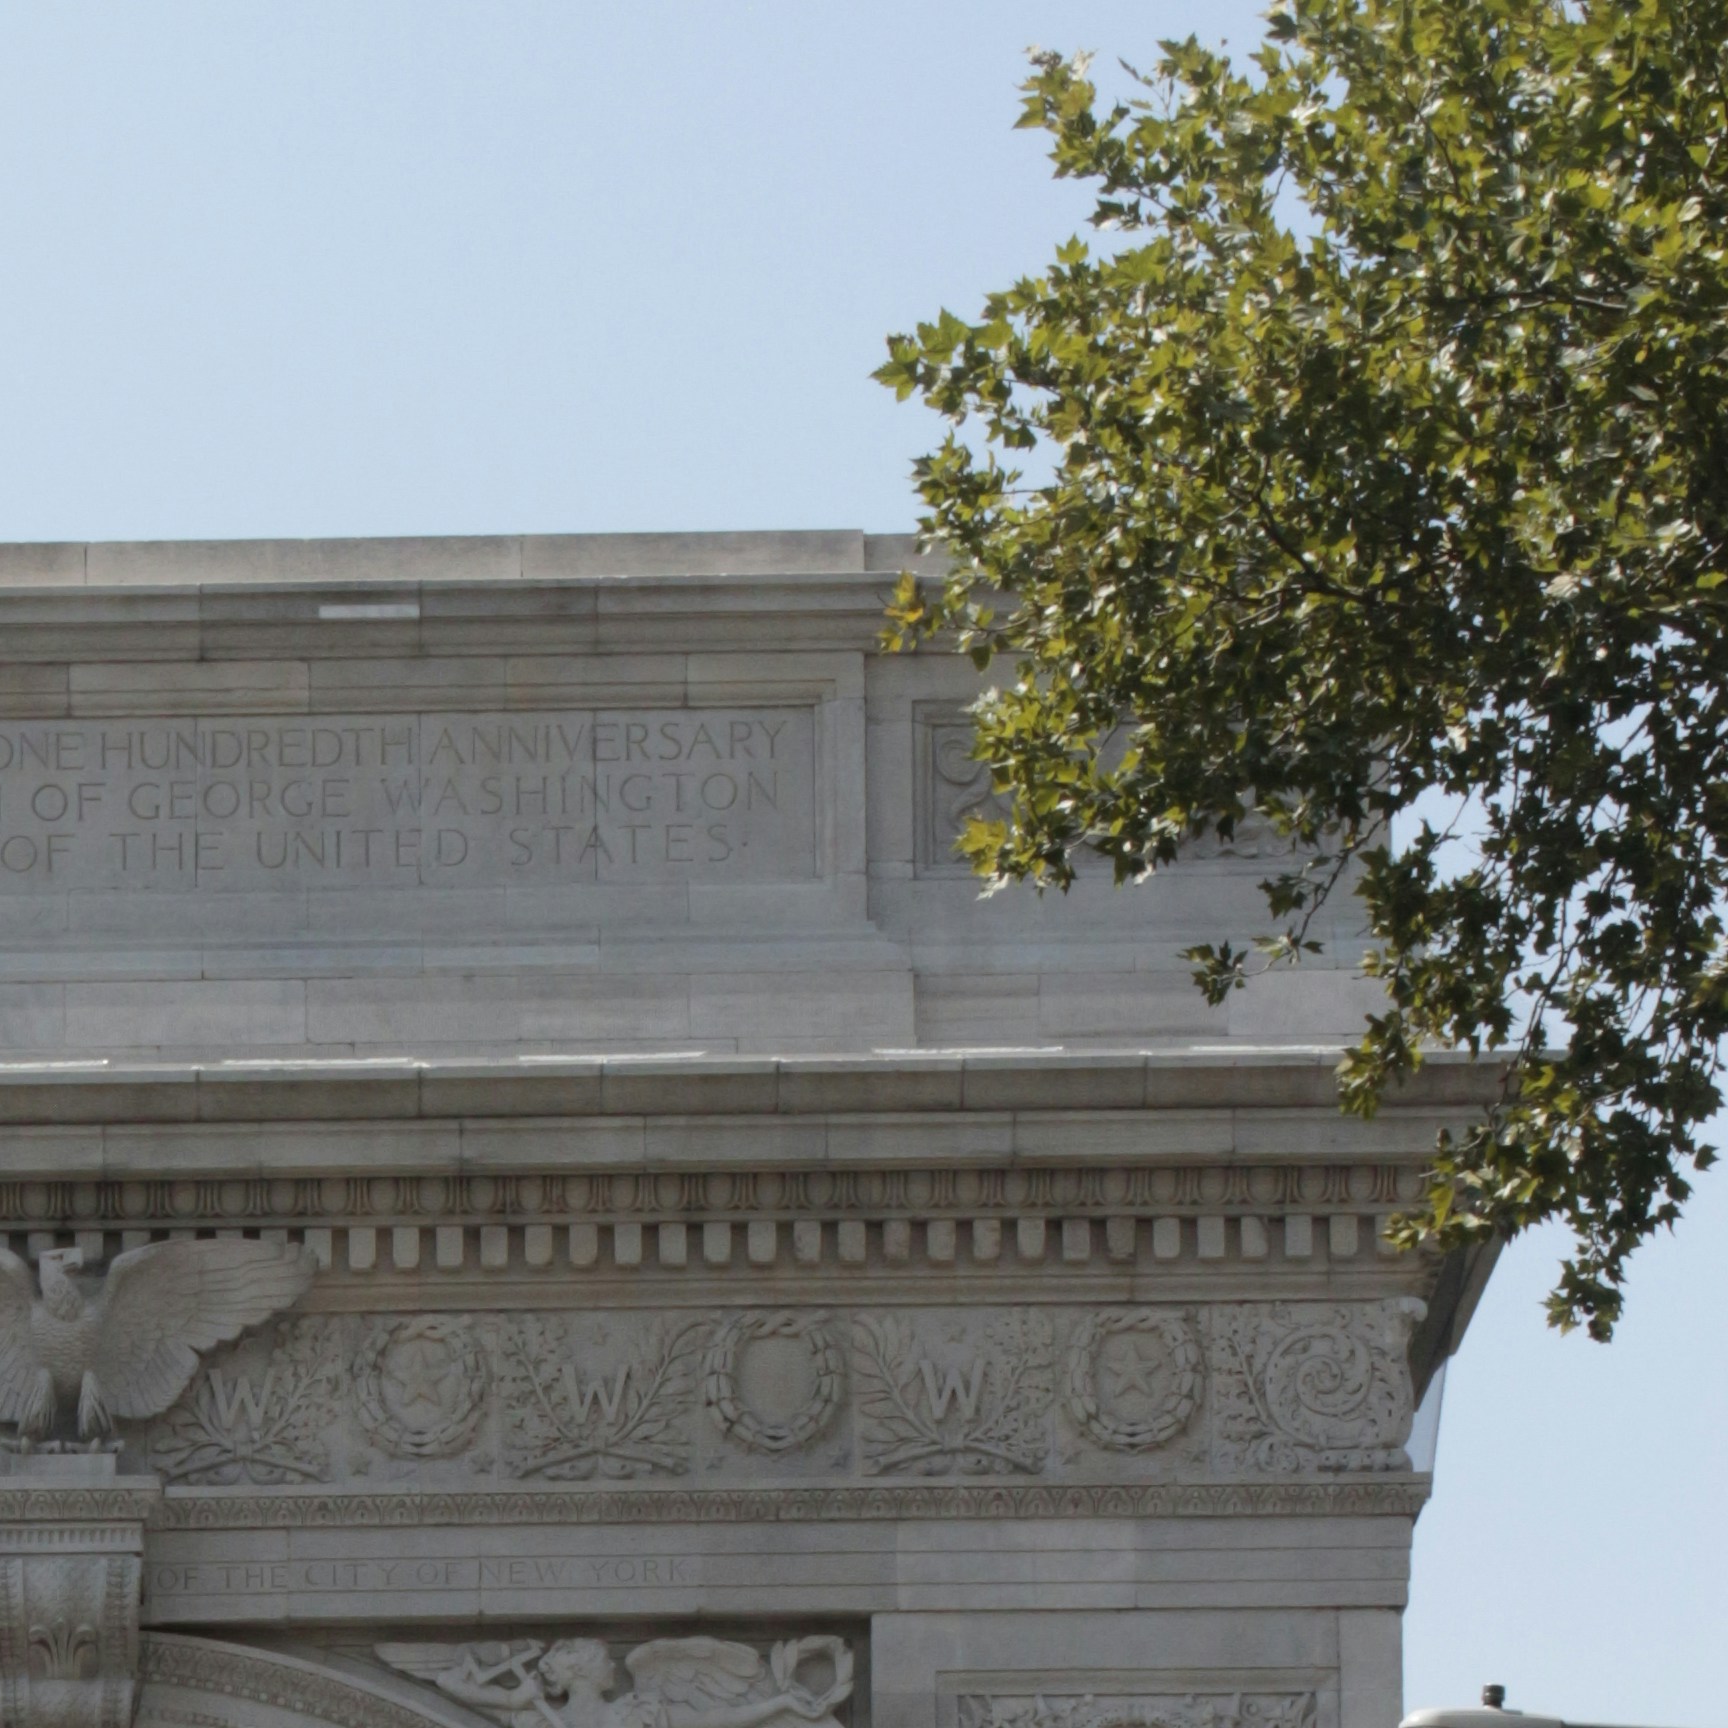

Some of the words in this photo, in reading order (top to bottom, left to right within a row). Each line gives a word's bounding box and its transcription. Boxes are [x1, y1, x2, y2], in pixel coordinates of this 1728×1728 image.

[100, 726, 413, 771] HUNDREDTH
[429, 720, 788, 766] ANNIVERSARY
[30, 782, 108, 823] OF
[128, 779, 350, 821] GEORGE
[380, 770, 778, 817] WASHINGTON
[0, 834, 76, 874] OF
[108, 831, 225, 871] THE
[256, 828, 469, 869] UNITED
[207, 1367, 274, 1429] W
[563, 1364, 630, 1423] W
[919, 1358, 987, 1420] W
[156, 1565, 199, 1591] OF
[218, 1564, 288, 1590] THE
[305, 1562, 397, 1588] CITY
[415, 1561, 460, 1586] OF
[479, 1559, 562, 1585] NEW
[590, 1557, 687, 1584] YORK
